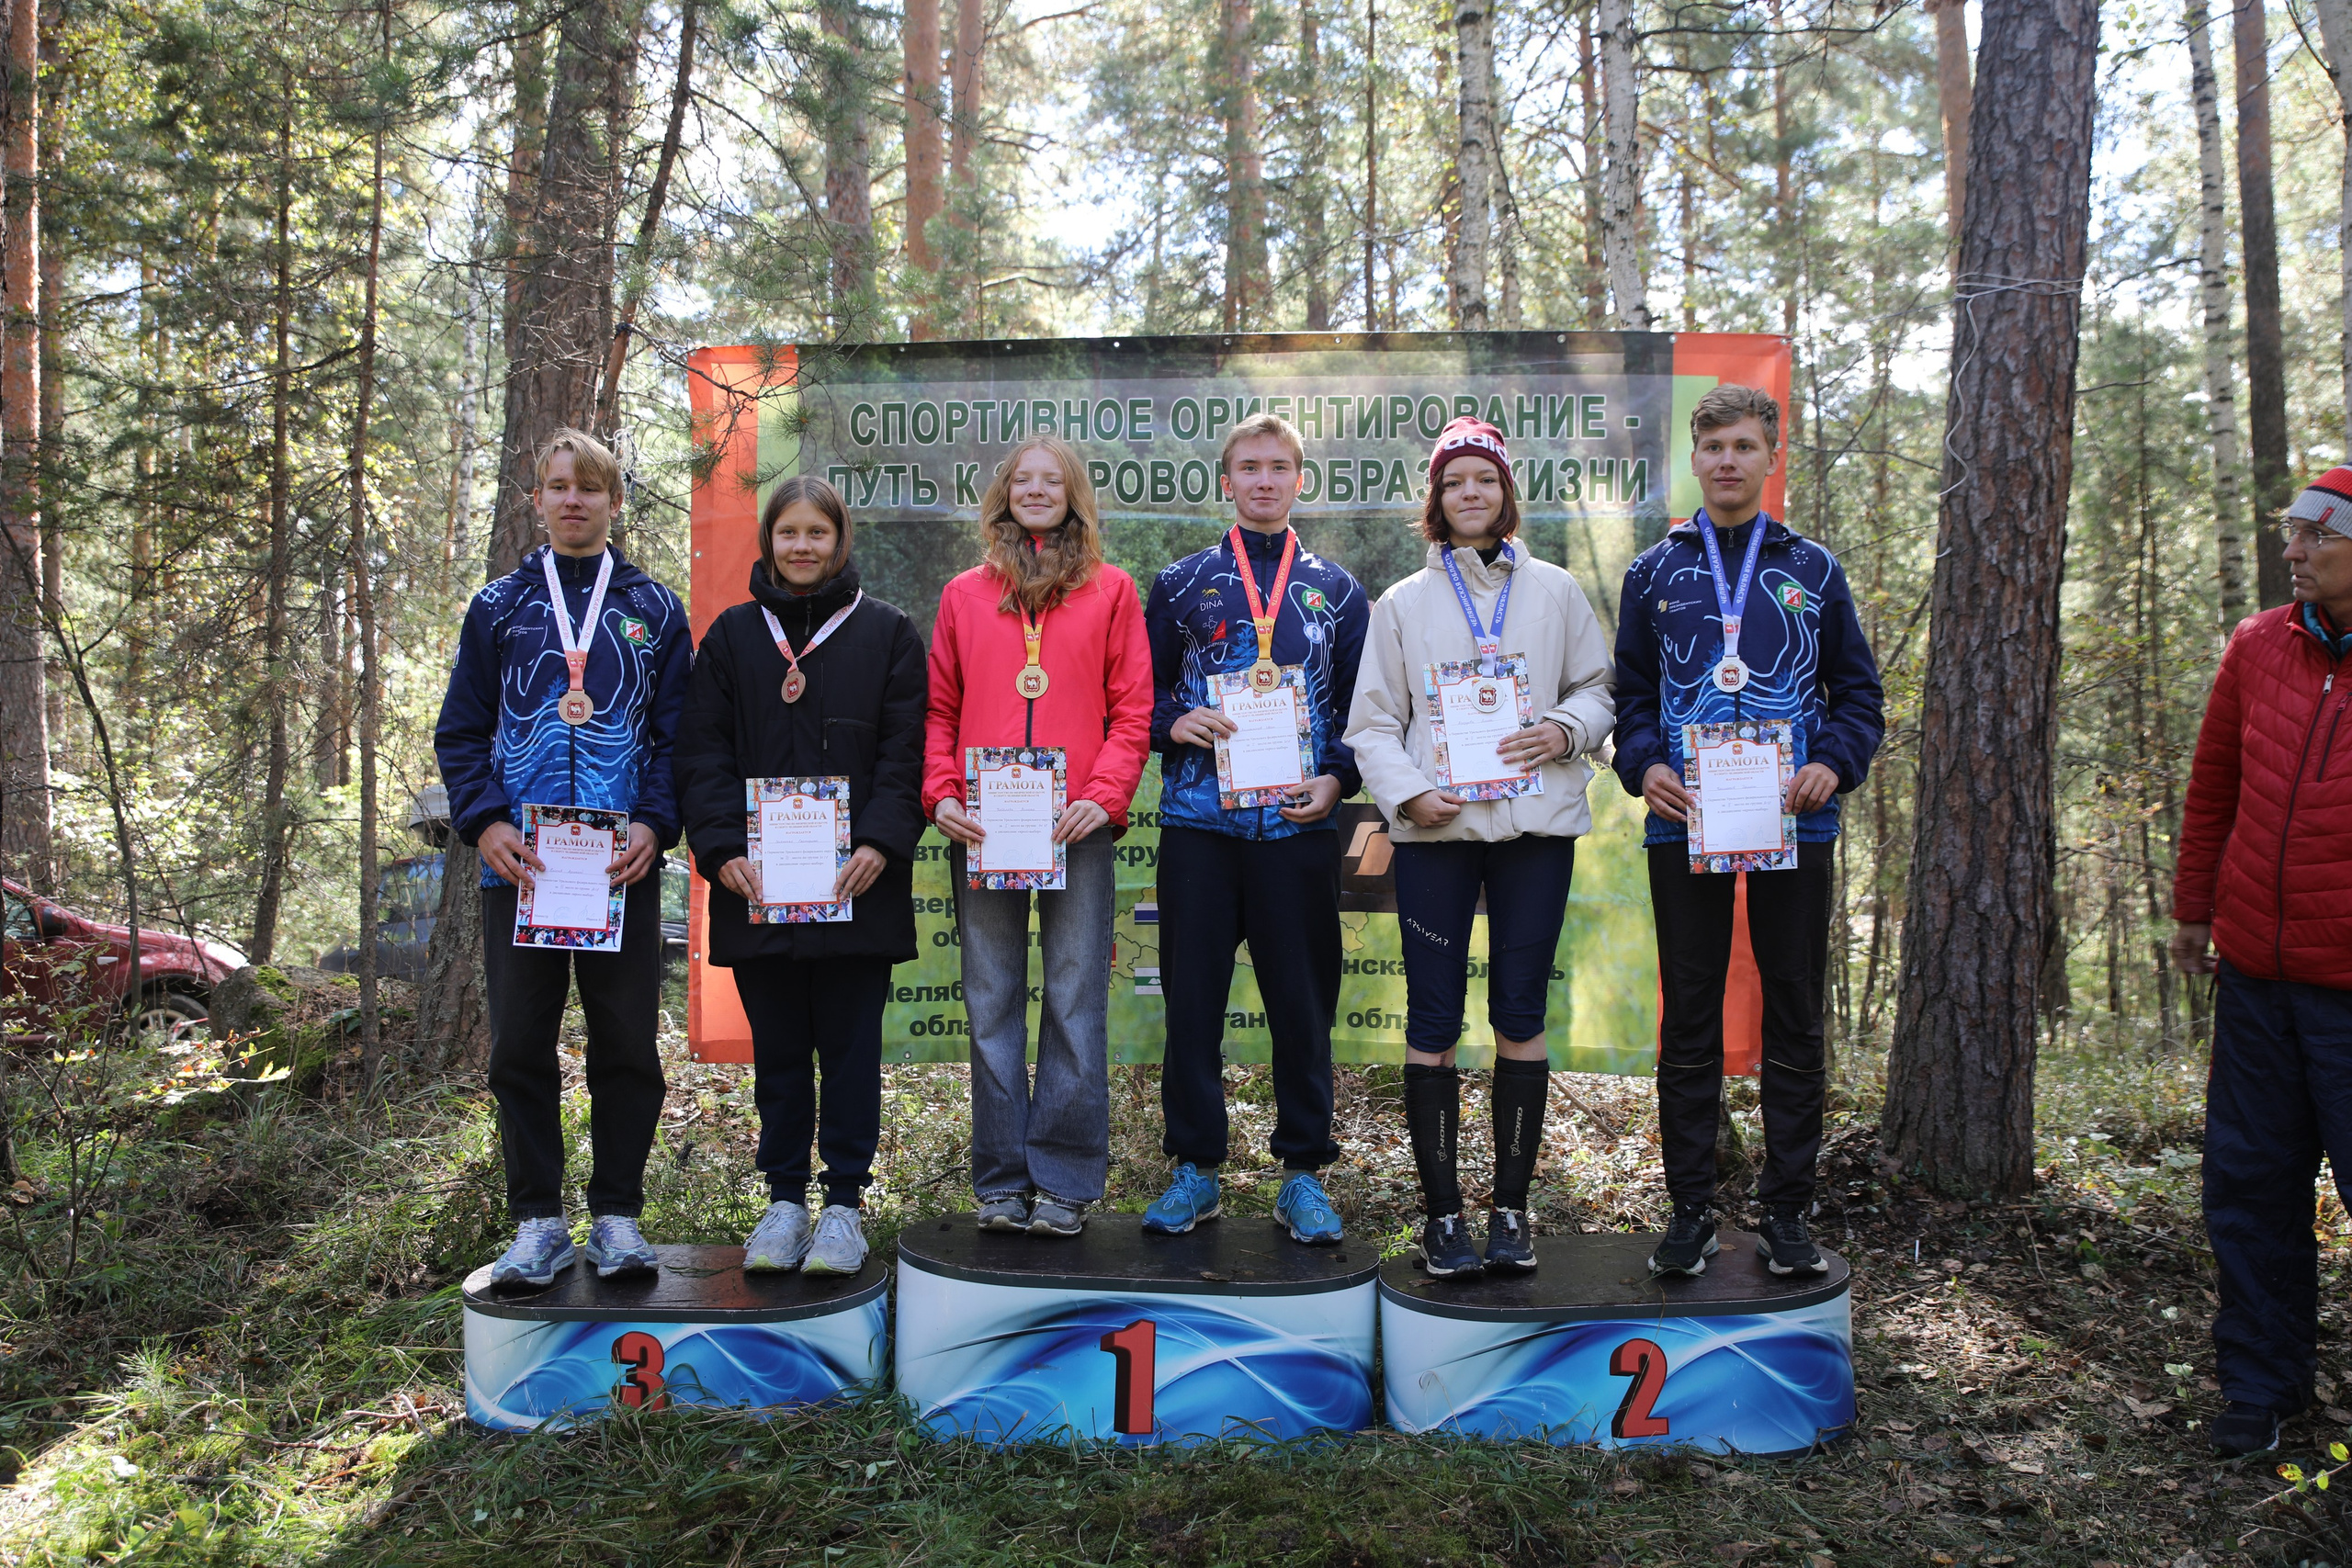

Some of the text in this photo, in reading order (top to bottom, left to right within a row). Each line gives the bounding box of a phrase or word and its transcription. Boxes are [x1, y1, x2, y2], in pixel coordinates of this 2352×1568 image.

[850, 398, 1153, 446] СПОРТИВНОЕ
[827, 463, 938, 507] ПУТЬ
[954, 463, 980, 505] К
[1704, 526, 1726, 604] ЧЕЛЯБИНСКАЯ ОБЛАСТЬ
[1200, 599, 1224, 612] DINA
[1445, 553, 1478, 626] ЧЕЛЯБИНСКАЯ ОБЛАСТЬ
[1736, 573, 1749, 604] ОБЛАСТЬ
[1495, 595, 1507, 624] ОБЛАСТЬ
[1232, 698, 1287, 712] ГРАМОТА
[1708, 756, 1770, 768] ГРАМОТА
[989, 780, 1045, 790] ГРАМОТА
[769, 811, 828, 821] ГРАМОТА
[546, 836, 605, 849] ГРАМОТА
[1514, 1106, 1523, 1146] NORD
[611, 1330, 666, 1412] 3
[1100, 1319, 1157, 1436] 1
[1609, 1337, 1669, 1438] 2
